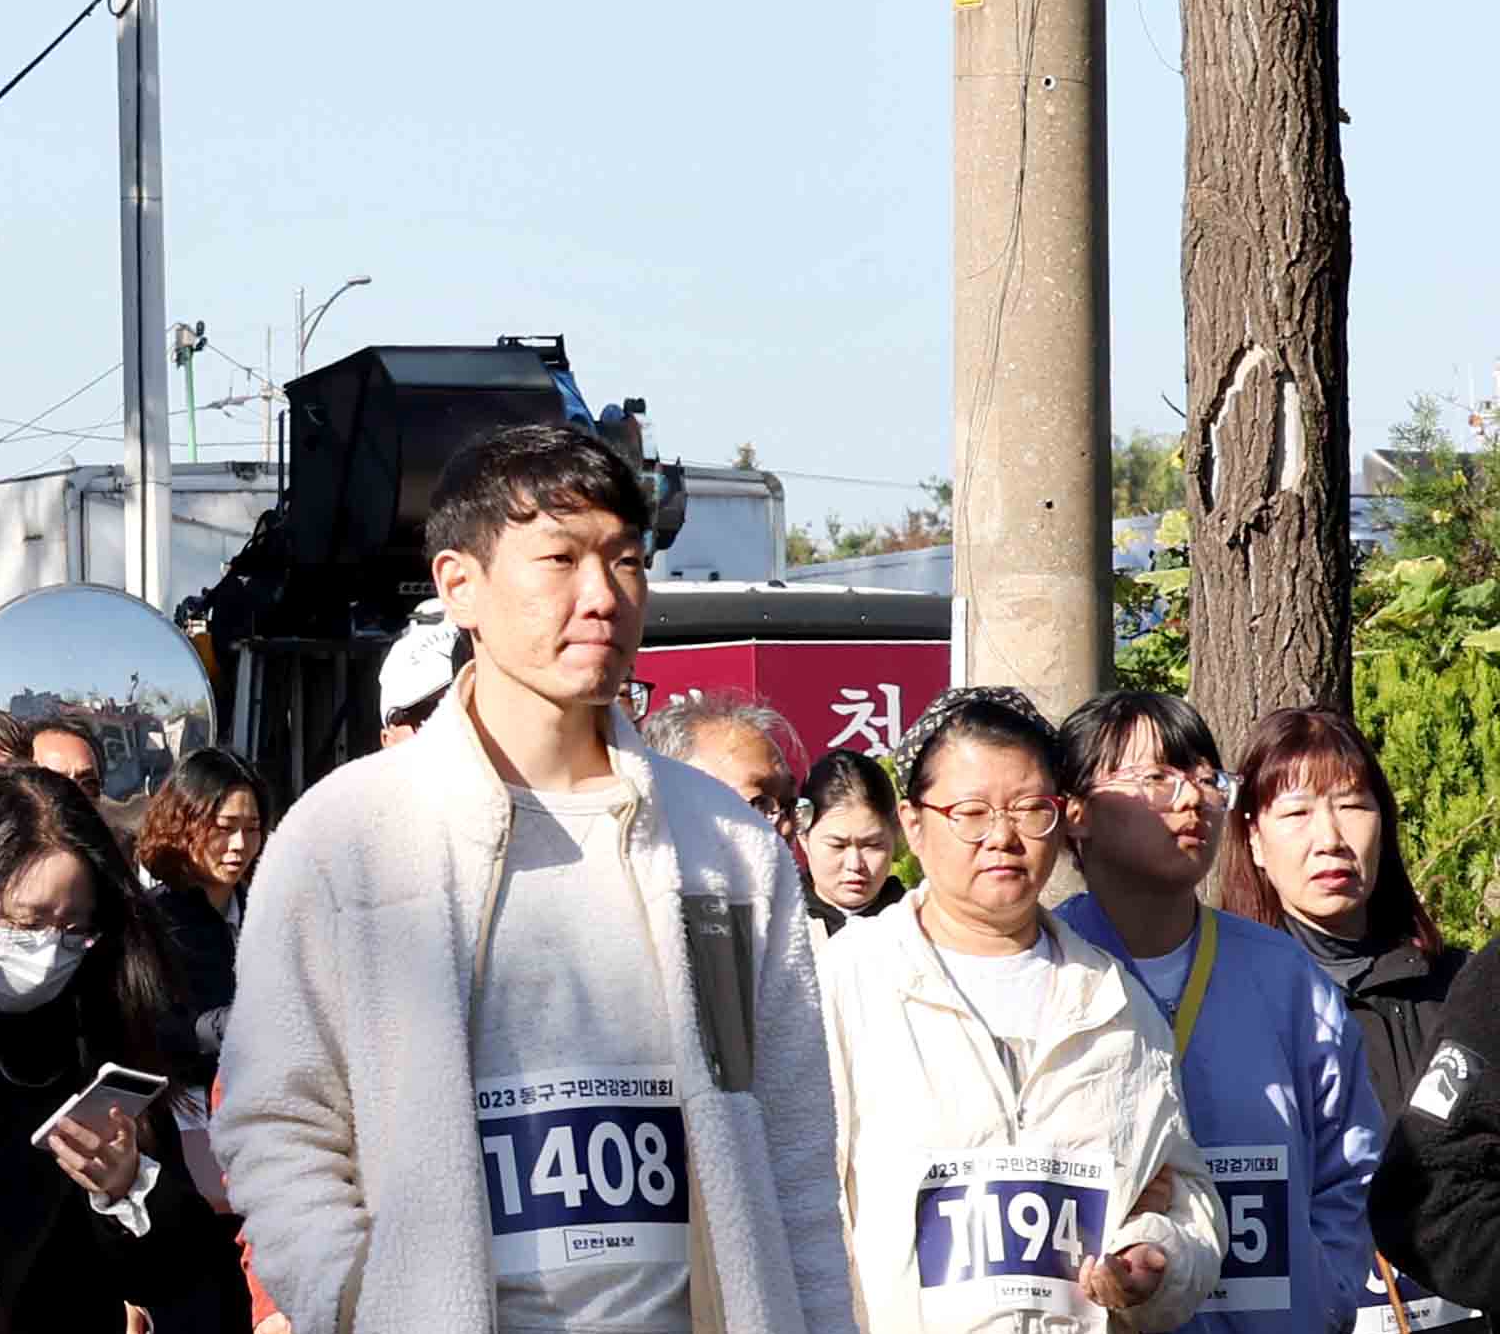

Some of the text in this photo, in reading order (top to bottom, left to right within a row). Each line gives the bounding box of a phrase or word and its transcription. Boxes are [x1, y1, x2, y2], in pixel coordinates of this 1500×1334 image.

[475, 1079, 674, 1110] 023 동구 구민건강걷기대회
[482, 1121, 676, 1216] 1408
[938, 1190, 1084, 1268] 1194
